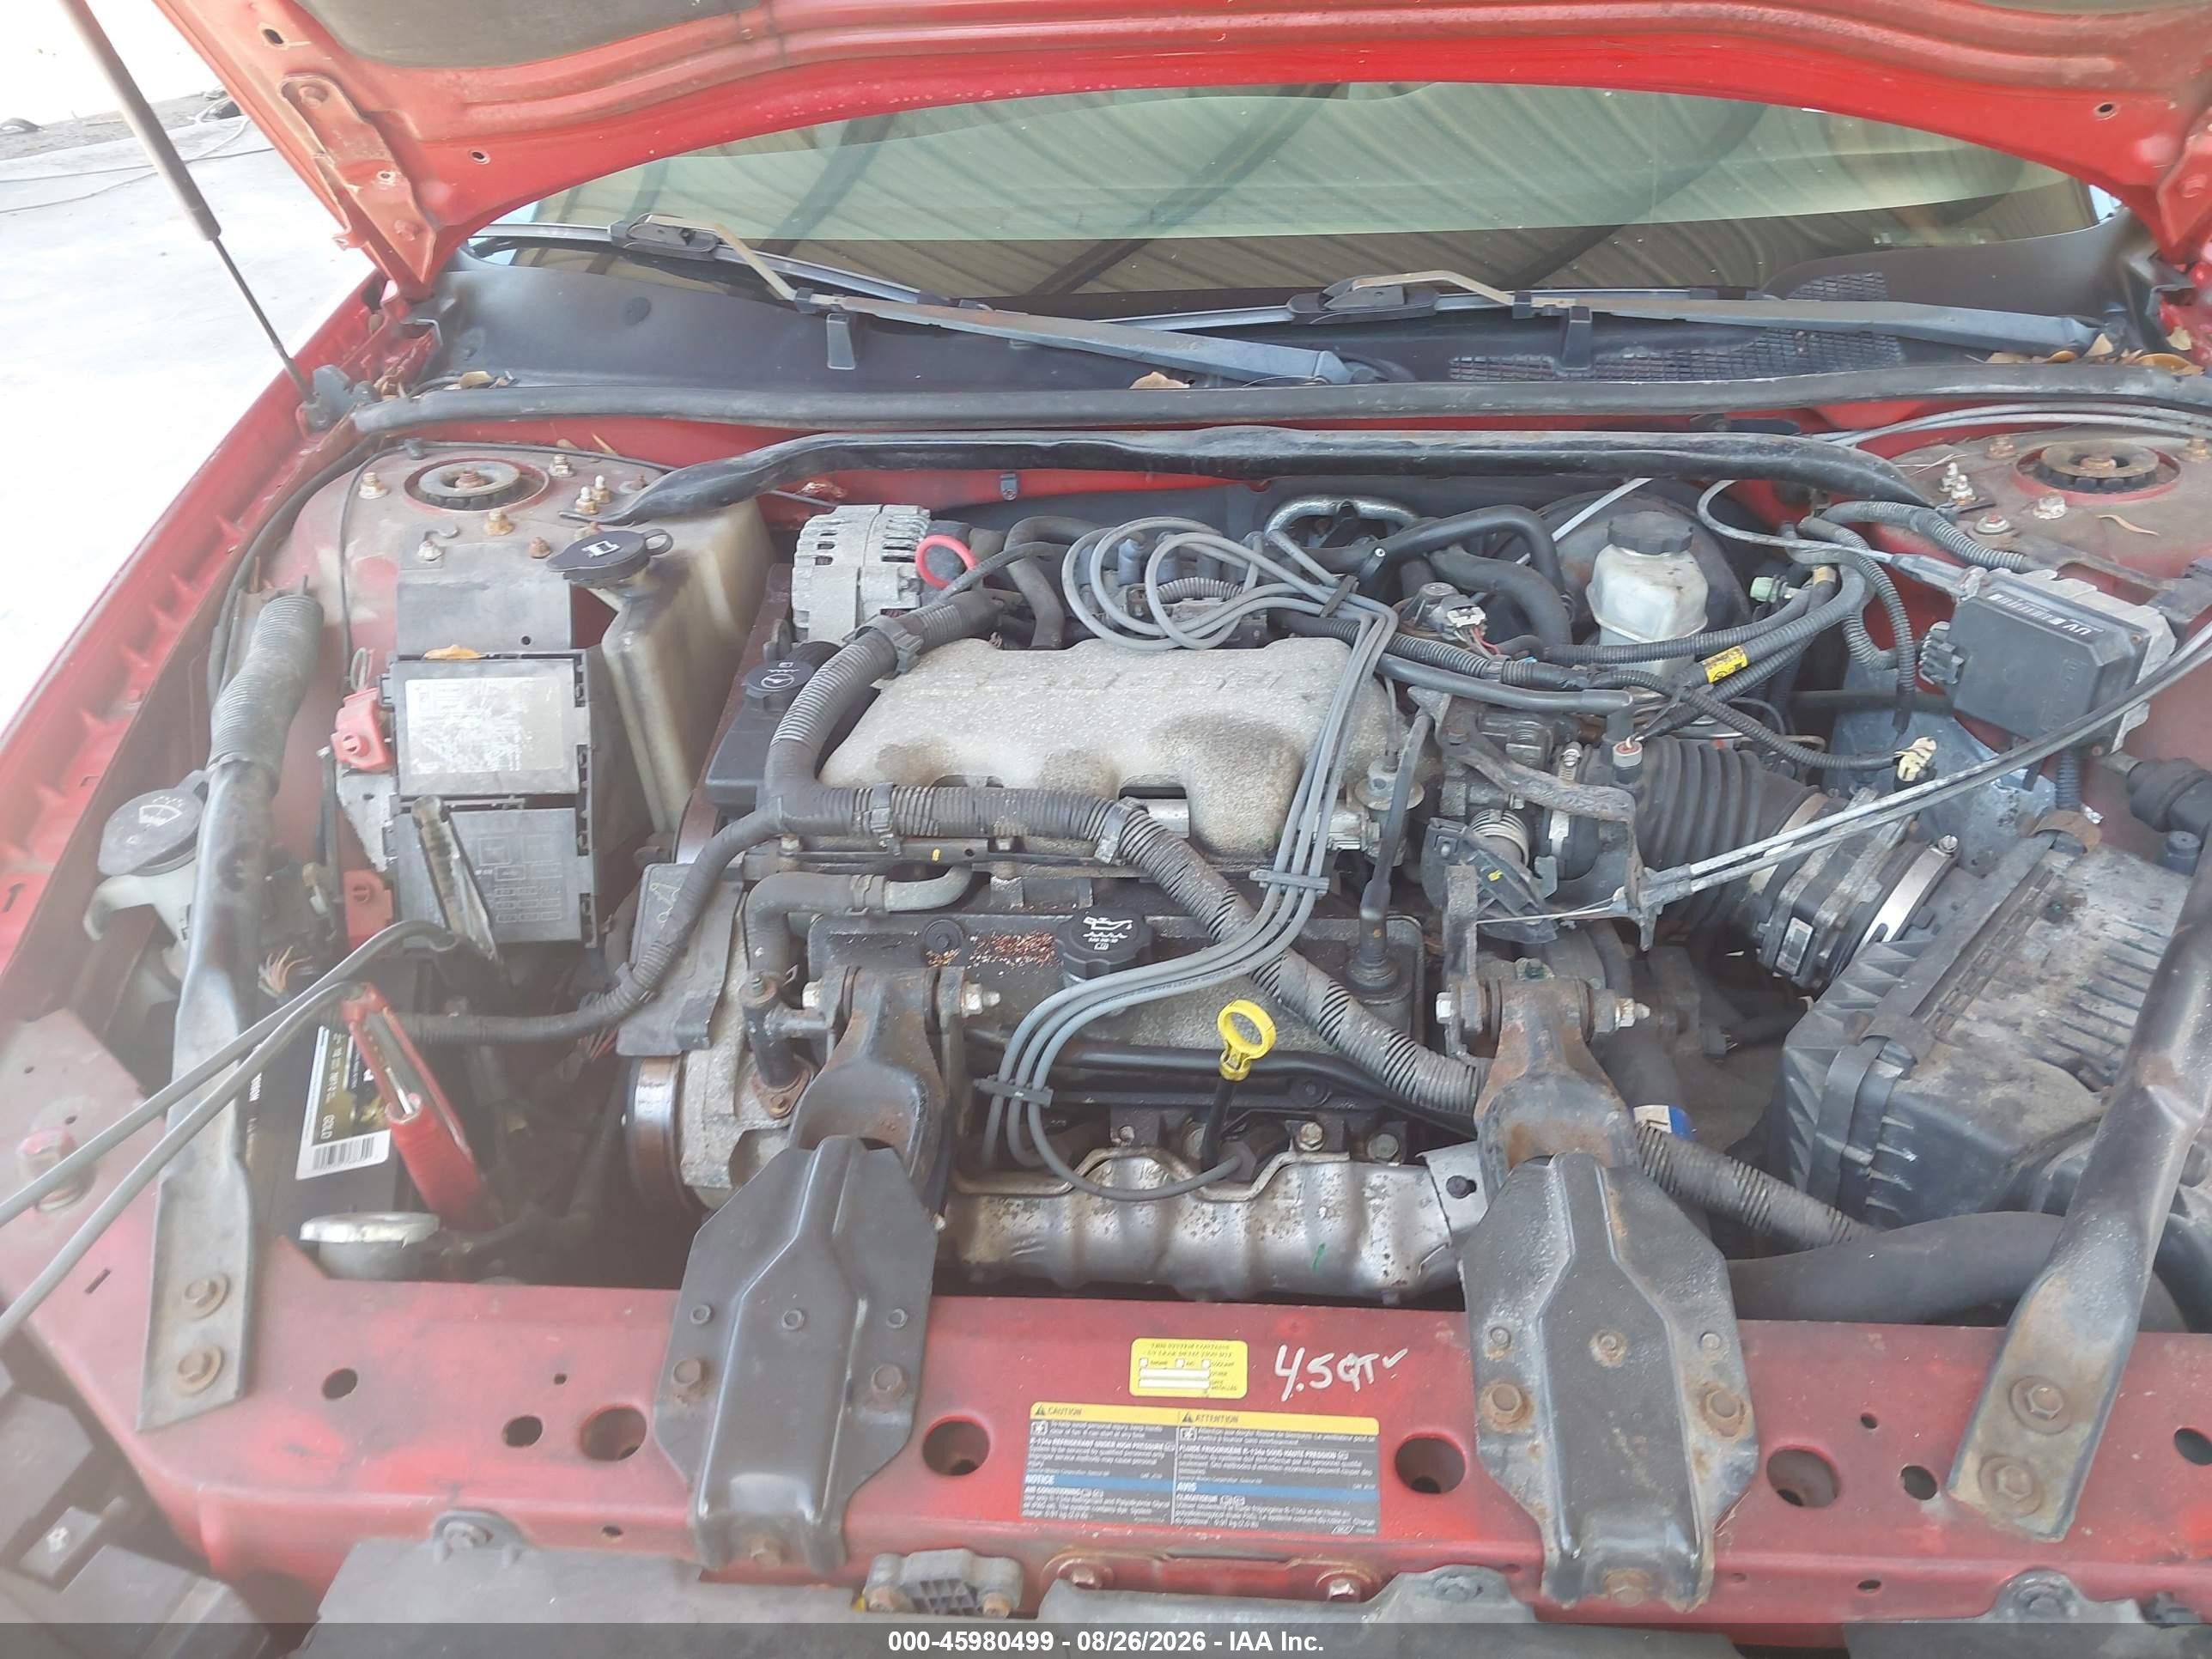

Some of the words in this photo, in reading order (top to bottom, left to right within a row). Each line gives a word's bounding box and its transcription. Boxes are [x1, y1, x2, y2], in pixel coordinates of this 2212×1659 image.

[320, 1114, 336, 1139] GOLD
[1048, 1407, 1083, 1417] CAUTION
[1194, 1413, 1239, 1424] ATTENTION
[1024, 1474, 1055, 1485] NOTICE
